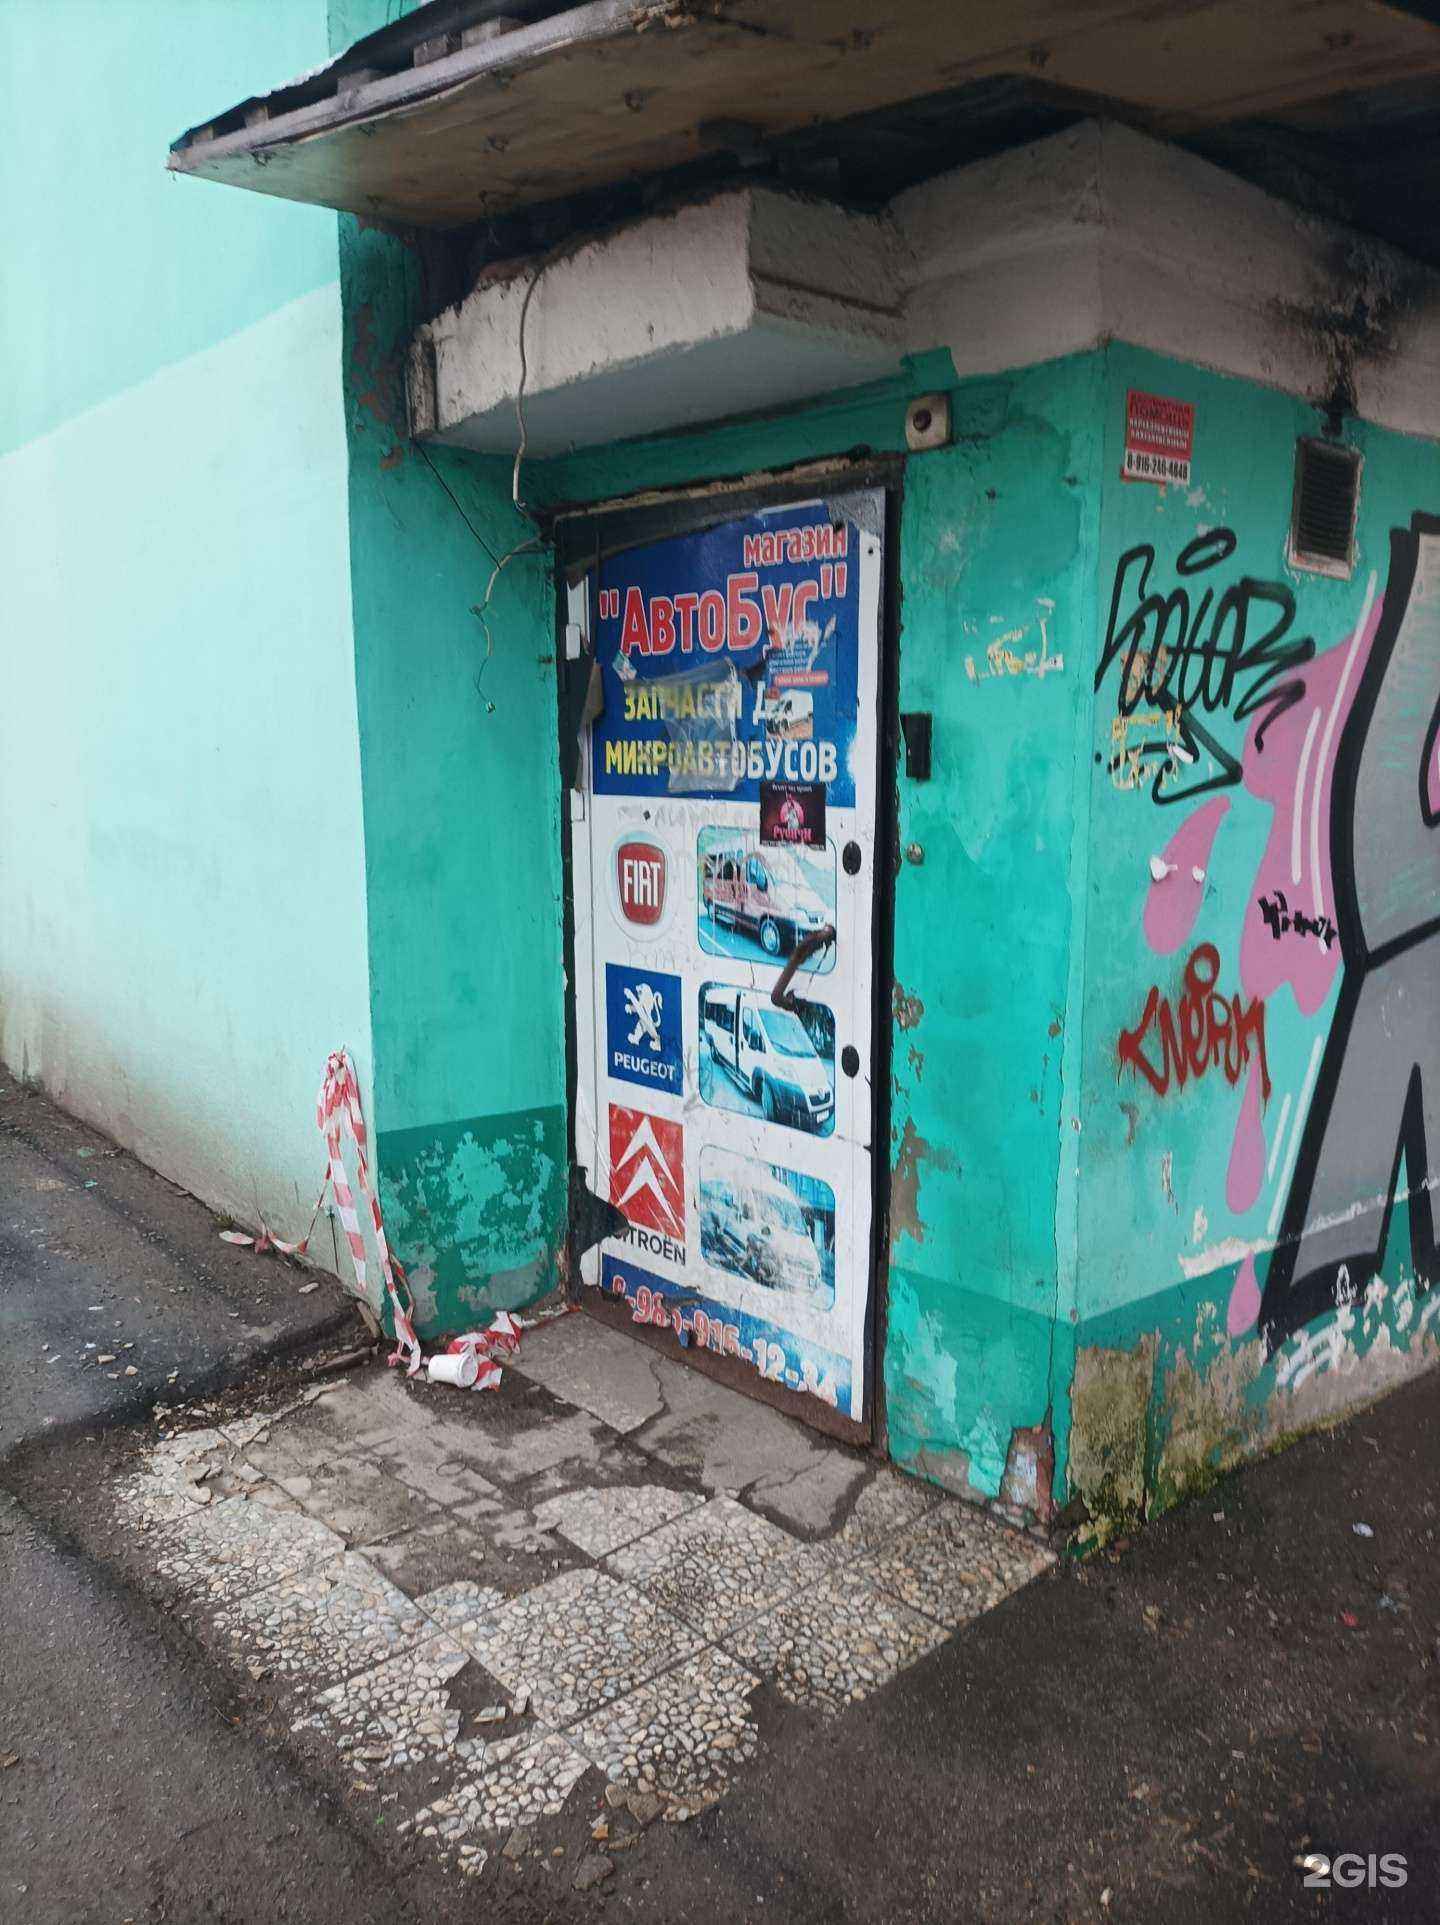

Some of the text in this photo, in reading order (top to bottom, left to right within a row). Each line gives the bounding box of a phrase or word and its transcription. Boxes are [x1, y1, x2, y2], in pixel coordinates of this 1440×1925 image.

[605, 739, 839, 783] МИКРОАВТОБУСОВ
[623, 858, 661, 908] FIAT
[614, 1051, 676, 1082] PEUGEOT
[613, 1225, 686, 1267] ITROËN
